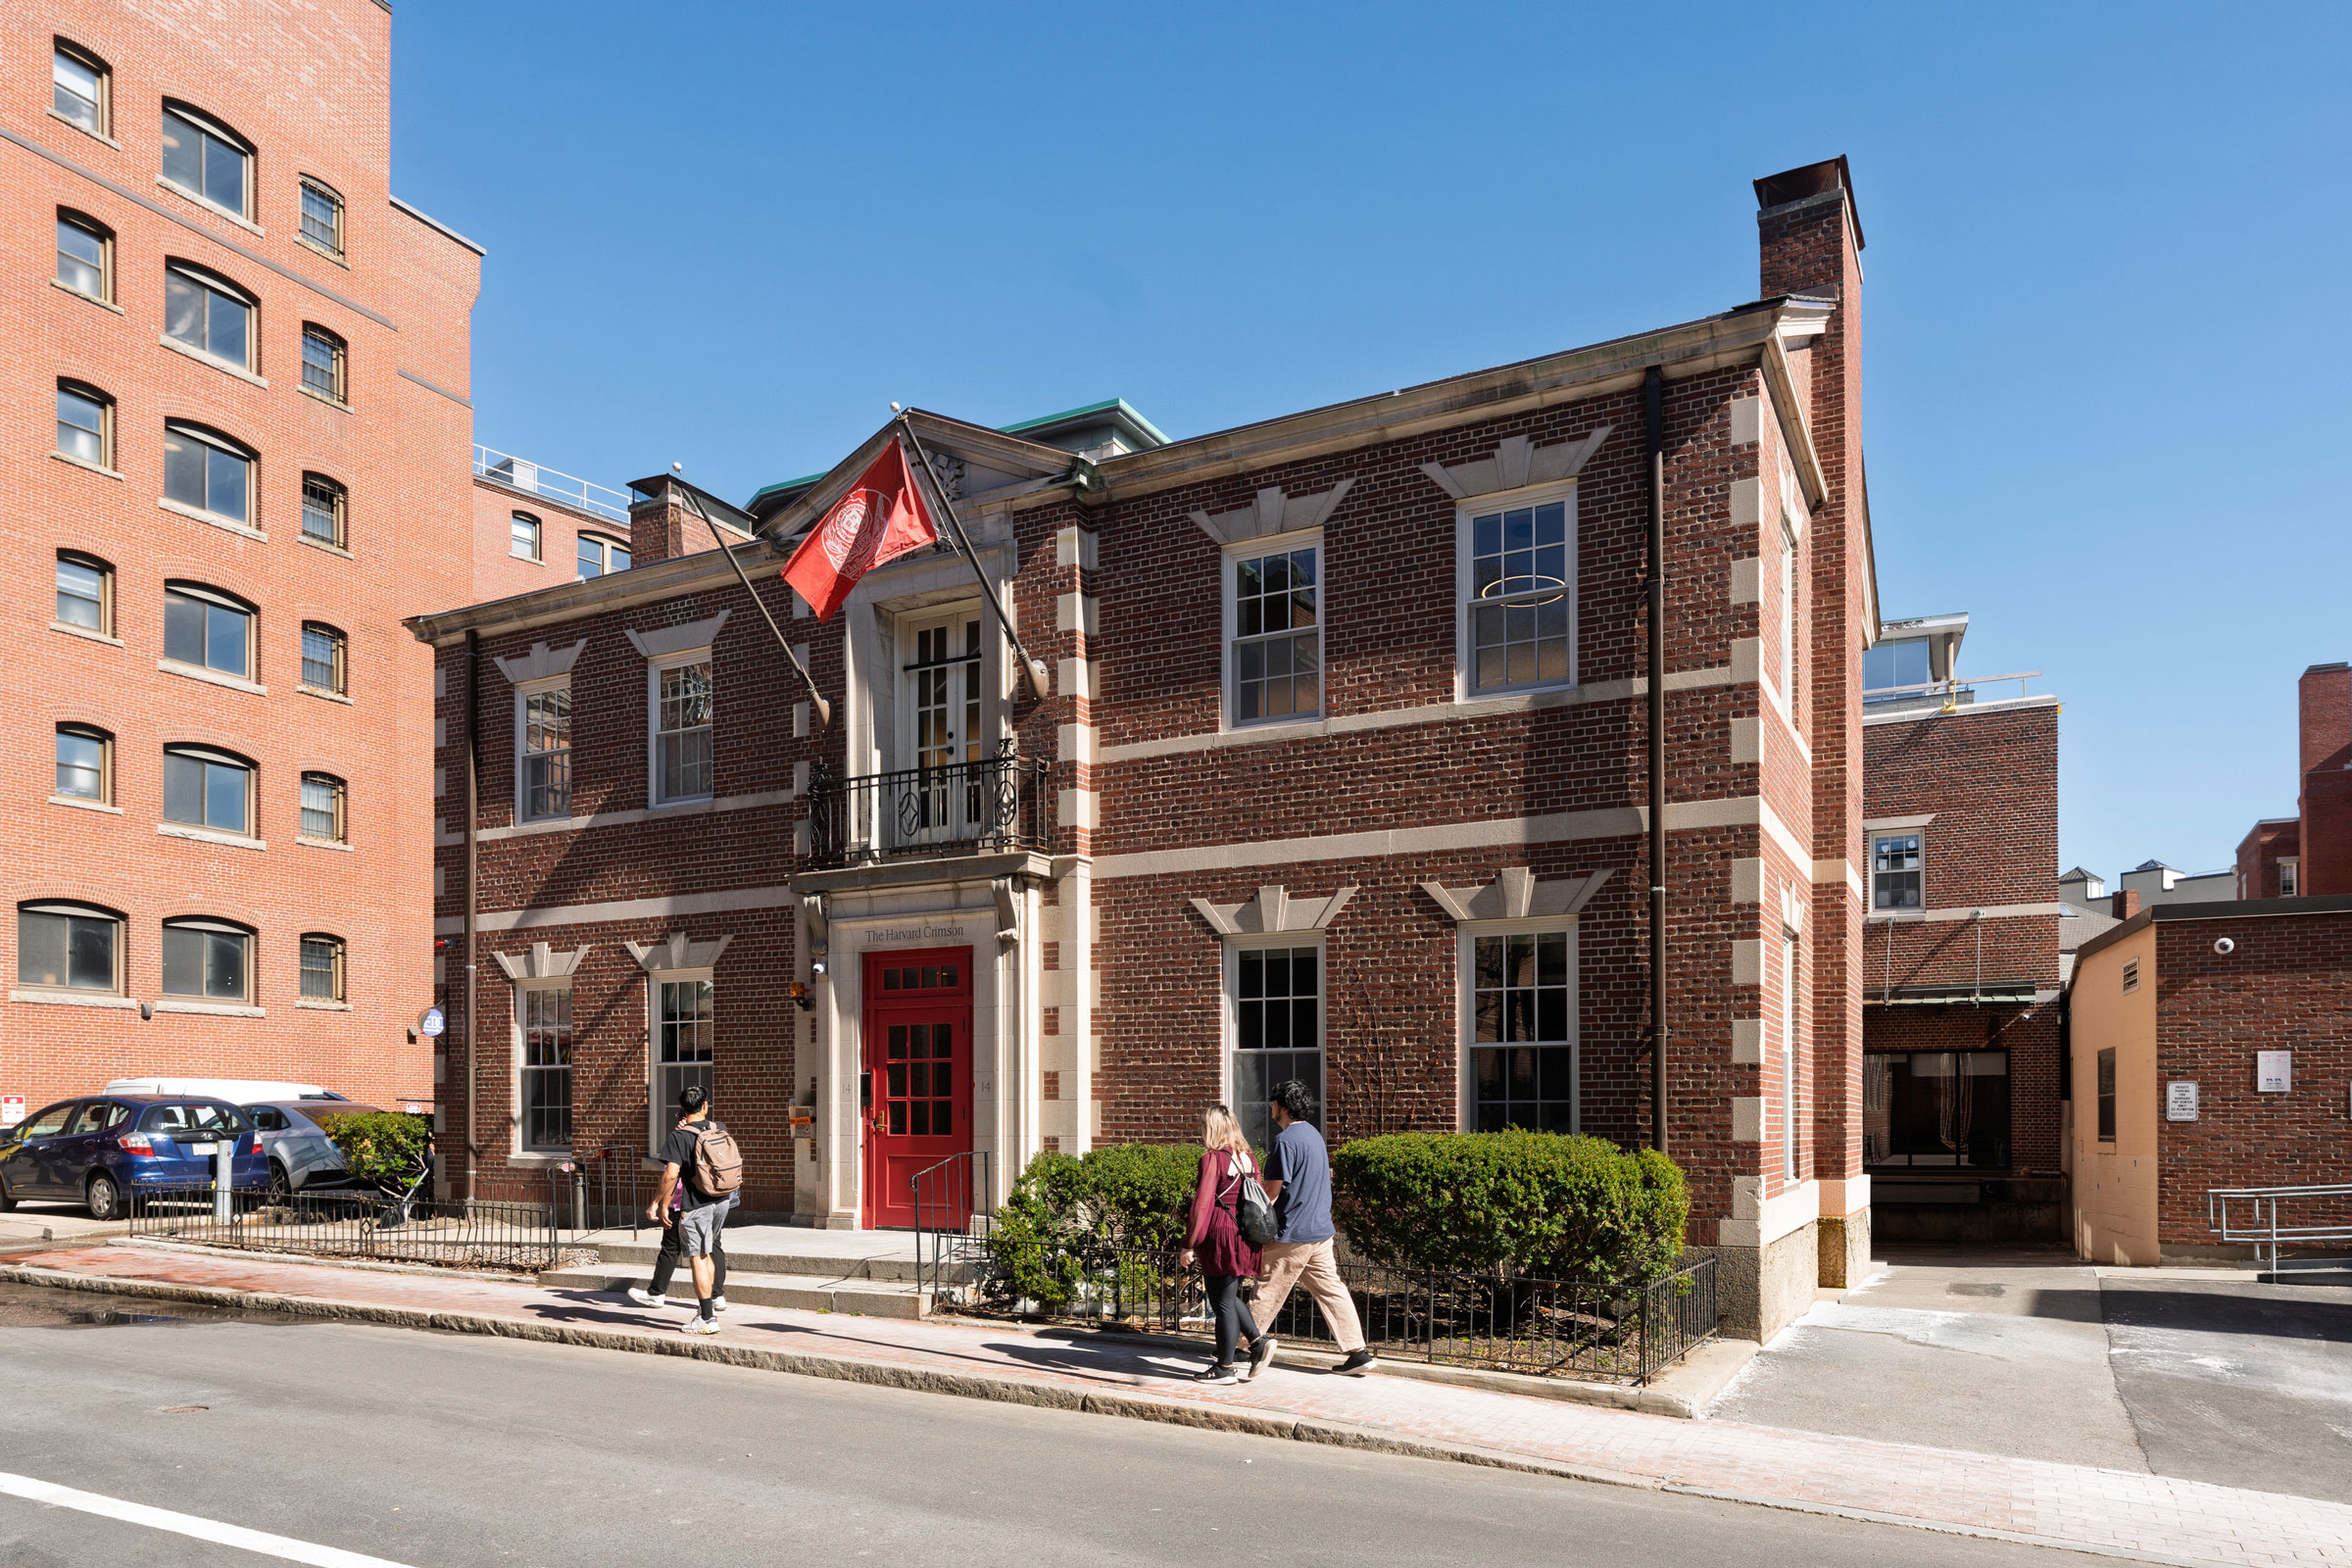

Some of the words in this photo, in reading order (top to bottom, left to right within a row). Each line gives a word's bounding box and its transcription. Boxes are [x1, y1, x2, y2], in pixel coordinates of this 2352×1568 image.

[865, 930, 884, 942] The
[885, 927, 921, 941] Harvard
[923, 925, 964, 939] Crimson
[981, 1081, 991, 1093] 14
